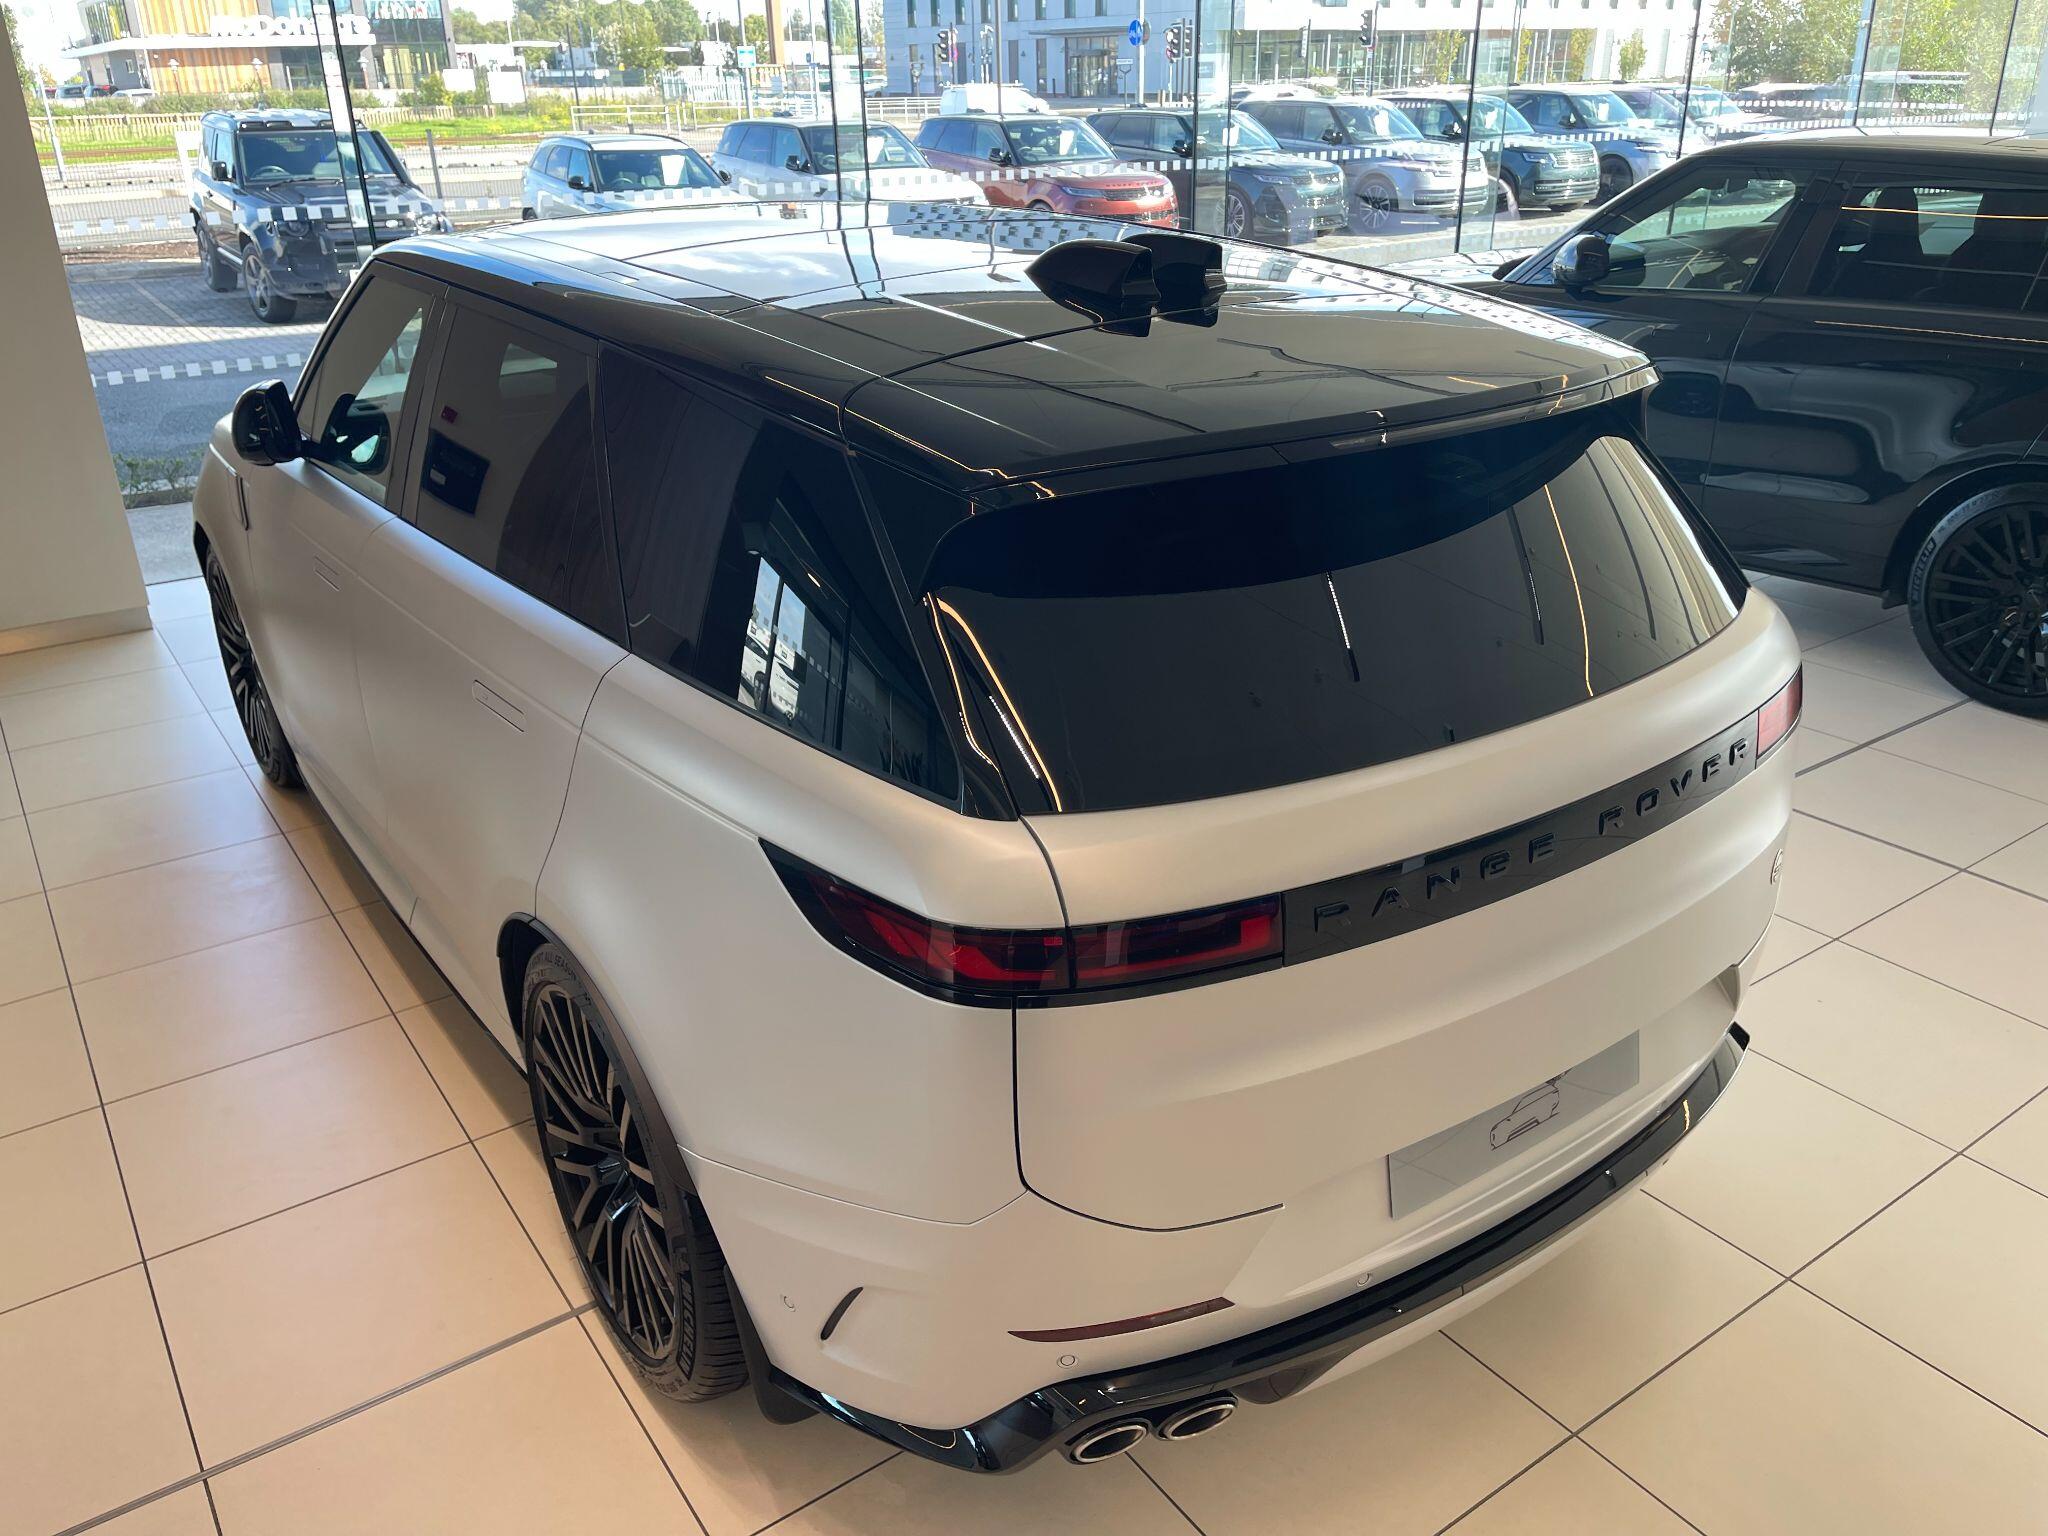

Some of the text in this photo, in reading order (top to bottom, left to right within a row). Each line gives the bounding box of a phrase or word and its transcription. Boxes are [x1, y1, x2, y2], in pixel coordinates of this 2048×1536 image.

[1313, 737, 1748, 934] RANGE ROVER
[678, 1277, 695, 1377] MICHELIN
